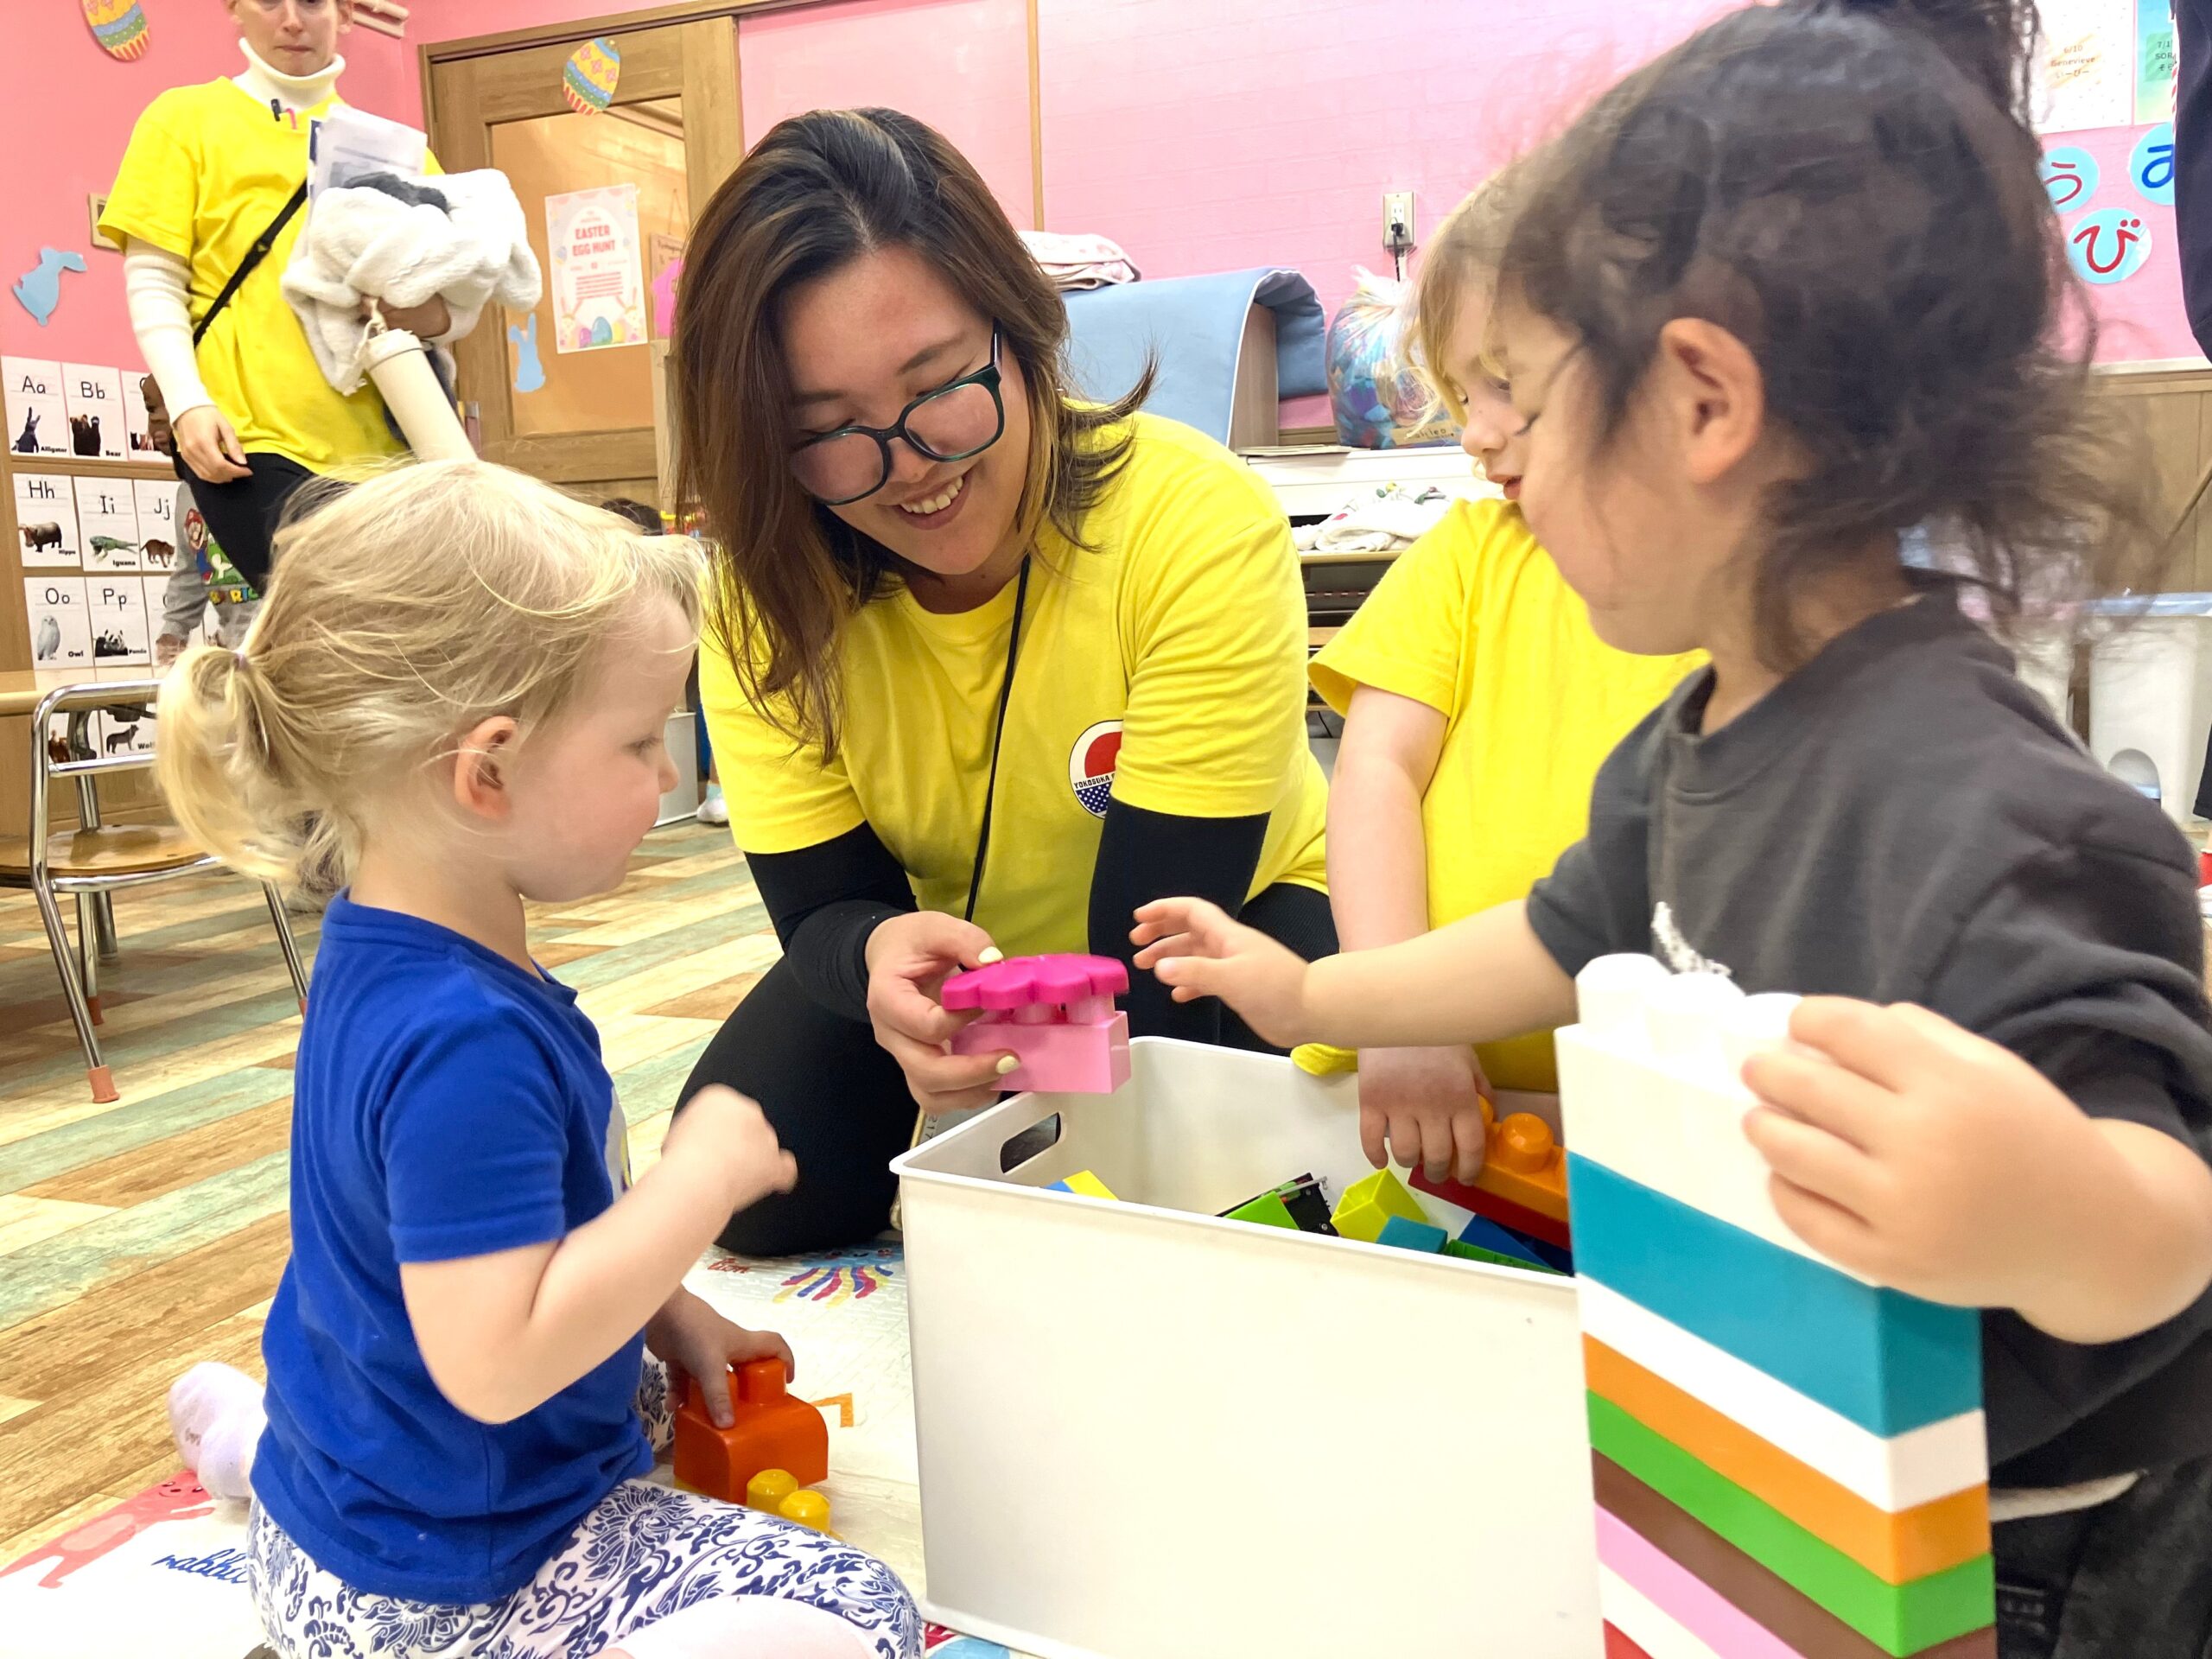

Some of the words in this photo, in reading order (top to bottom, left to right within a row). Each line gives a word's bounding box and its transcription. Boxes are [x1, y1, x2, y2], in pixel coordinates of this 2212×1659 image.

[2050, 56, 2095, 67] Genevieve
[2155, 52, 2175, 60] SOR
[575, 225, 610, 240] EASTER
[572, 243, 591, 257] EGG
[593, 239, 615, 253] HUNT
[22, 375, 46, 394] Aa
[80, 381, 105, 399] Bb
[29, 480, 55, 499] Hh
[99, 495, 115, 514] Ii
[154, 498, 170, 520] Jj
[45, 588, 70, 605] Oo
[103, 588, 127, 611] Pp
[1074, 774, 1110, 789] YOKOSUKA
